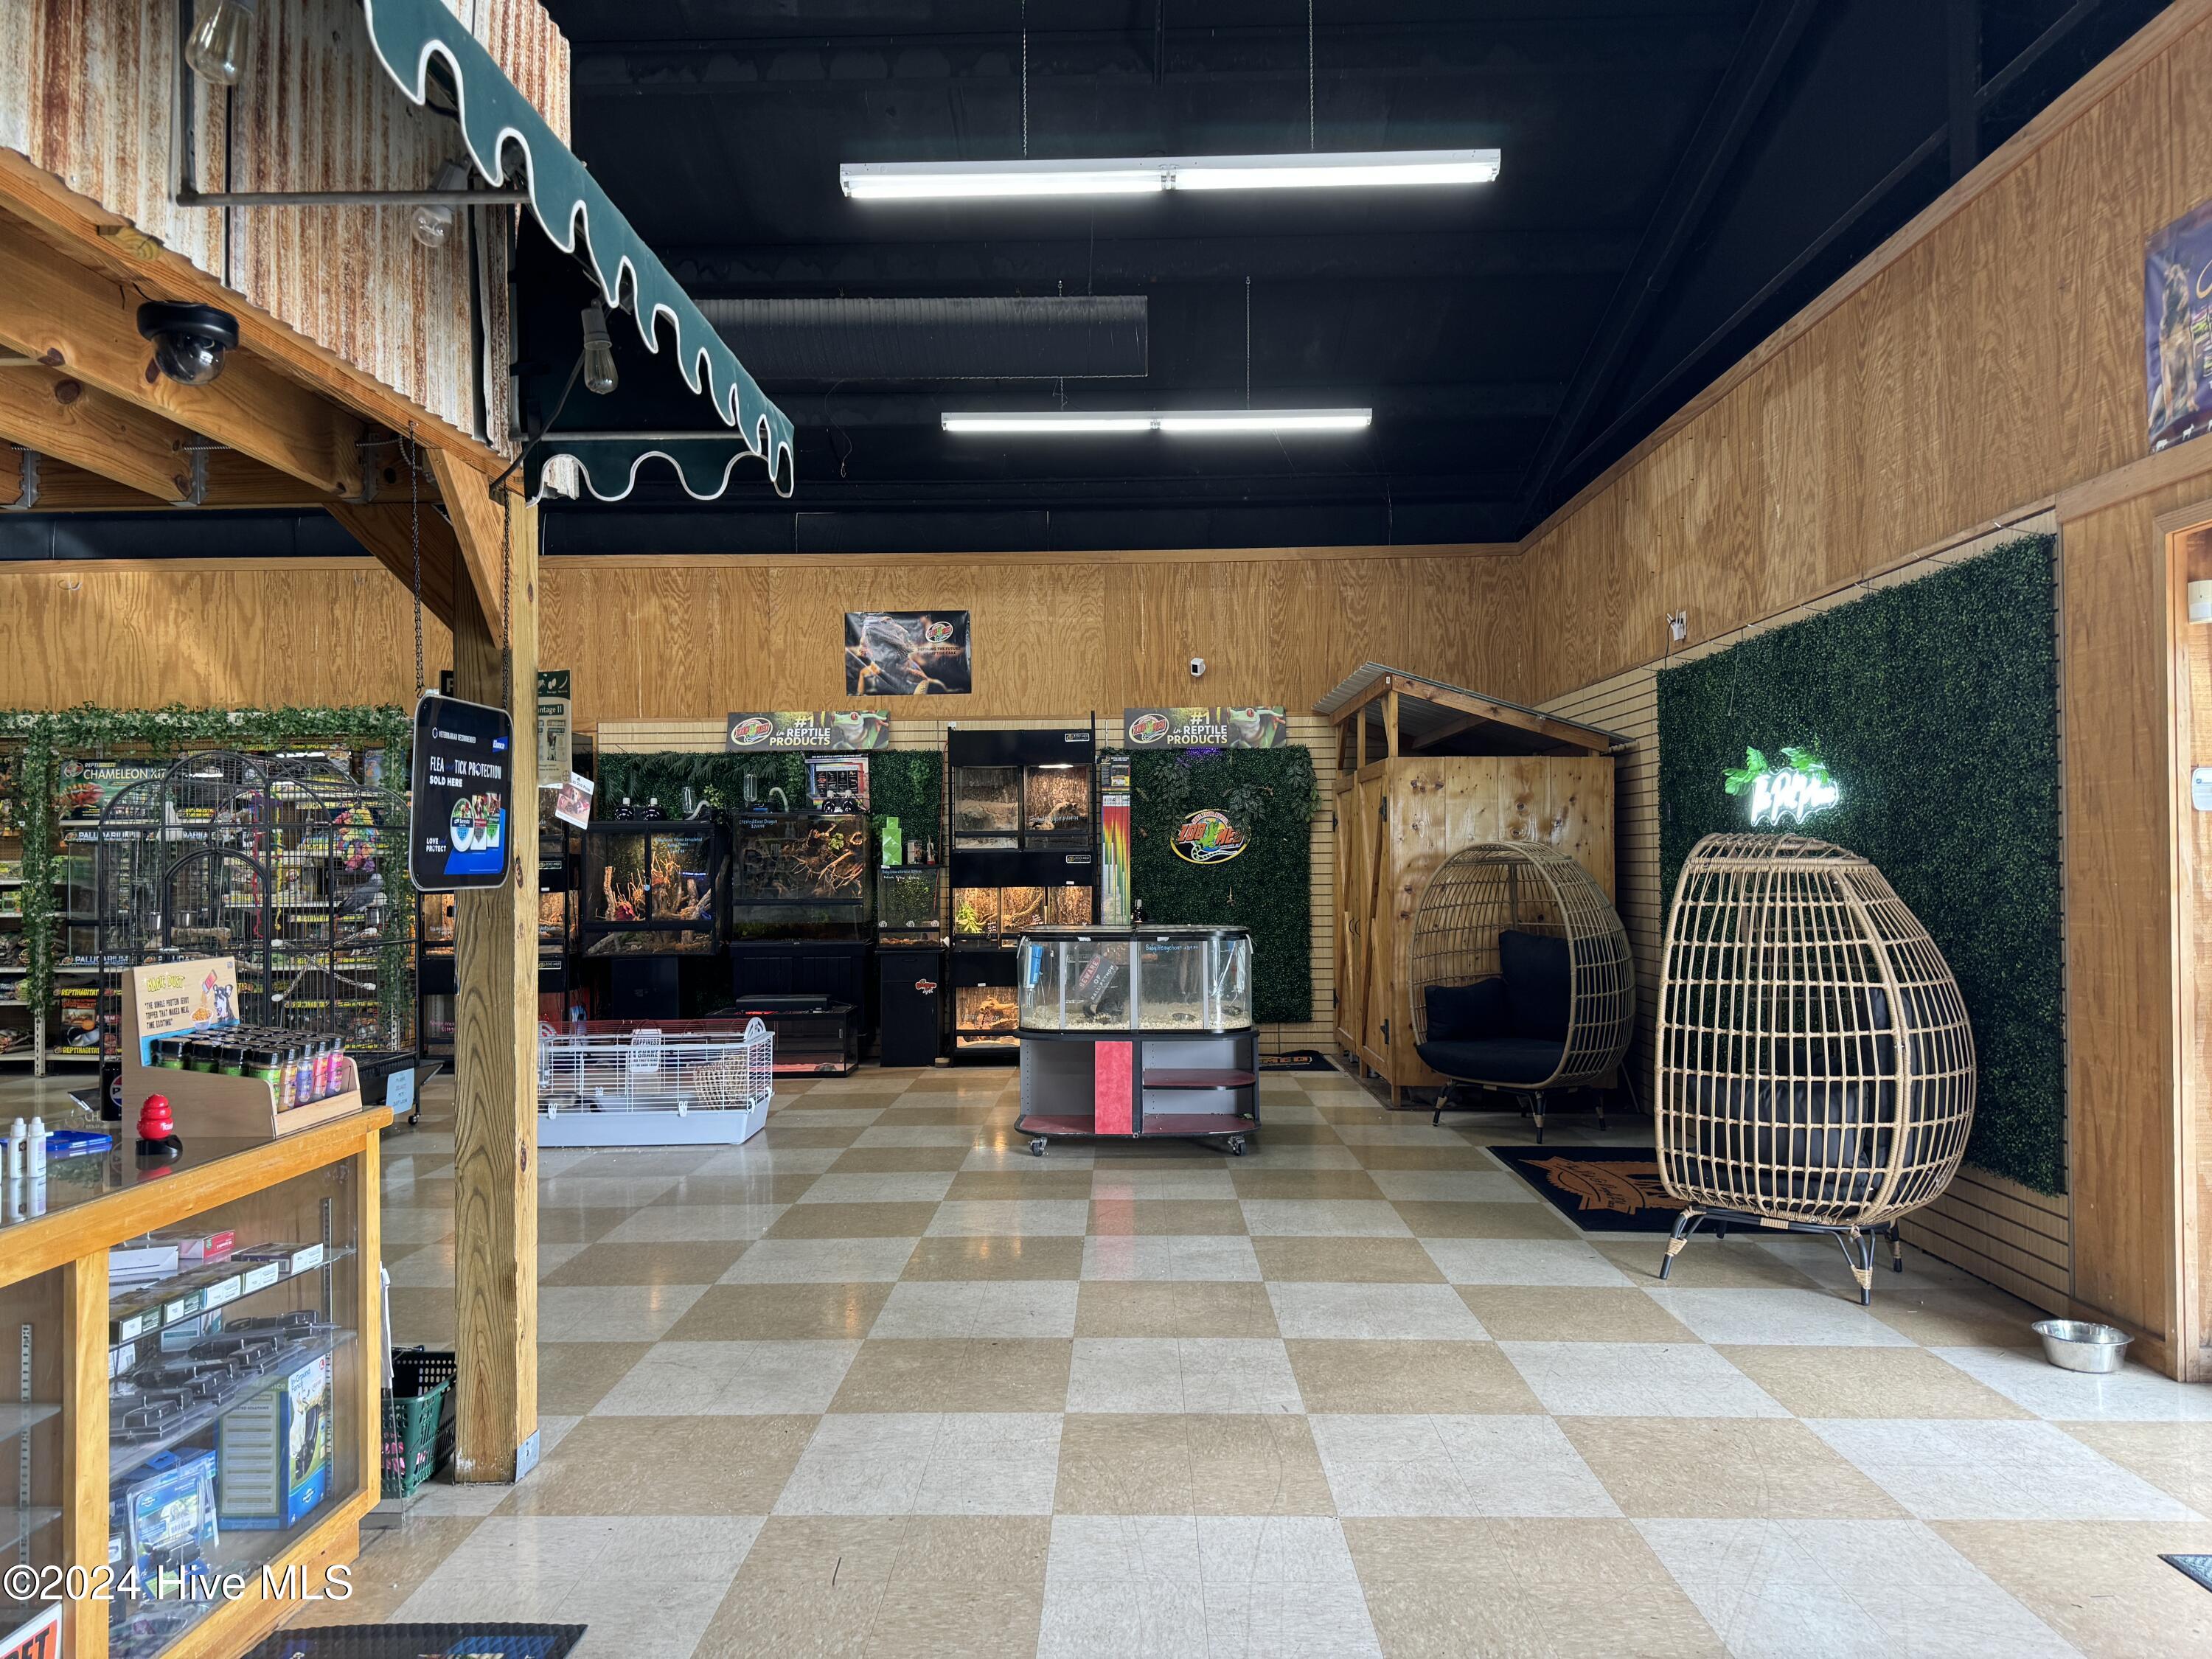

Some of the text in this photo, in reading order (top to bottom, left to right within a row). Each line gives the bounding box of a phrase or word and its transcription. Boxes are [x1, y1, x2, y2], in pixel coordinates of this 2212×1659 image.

[794, 715, 814, 728] #1
[1190, 712, 1210, 725] #1
[735, 726, 750, 737] ZOO
[787, 728, 830, 737] REPTILE
[1133, 723, 1147, 734] ZOO
[1183, 725, 1228, 734] REPTILE
[493, 740, 505, 750] Elanco
[769, 737, 830, 746] PRODUCTS
[1167, 735, 1228, 744] PRODUCTS
[430, 756, 445, 772] FLEA
[454, 759, 467, 775] TICK
[468, 761, 502, 779] PROTECTION
[83, 768, 147, 780] CHAMELEON
[429, 775, 463, 787] SOLD HERE
[1178, 823, 1207, 842] ZOO
[1145, 944, 1157, 953] Baby
[1079, 960, 1099, 987] BEWARE
[1093, 974, 1102, 984] OF
[147, 975, 184, 992] MAGIC DUST
[154, 1000, 166, 1009] SINGLE
[166, 998, 179, 1006] PROTEIN
[180, 996, 189, 1004] JERKY
[145, 1006, 189, 1020] TOPPER THAT MAKES MEAL
[146, 1020, 155, 1029] TIME
[637, 1049, 658, 1058] SNAKE
